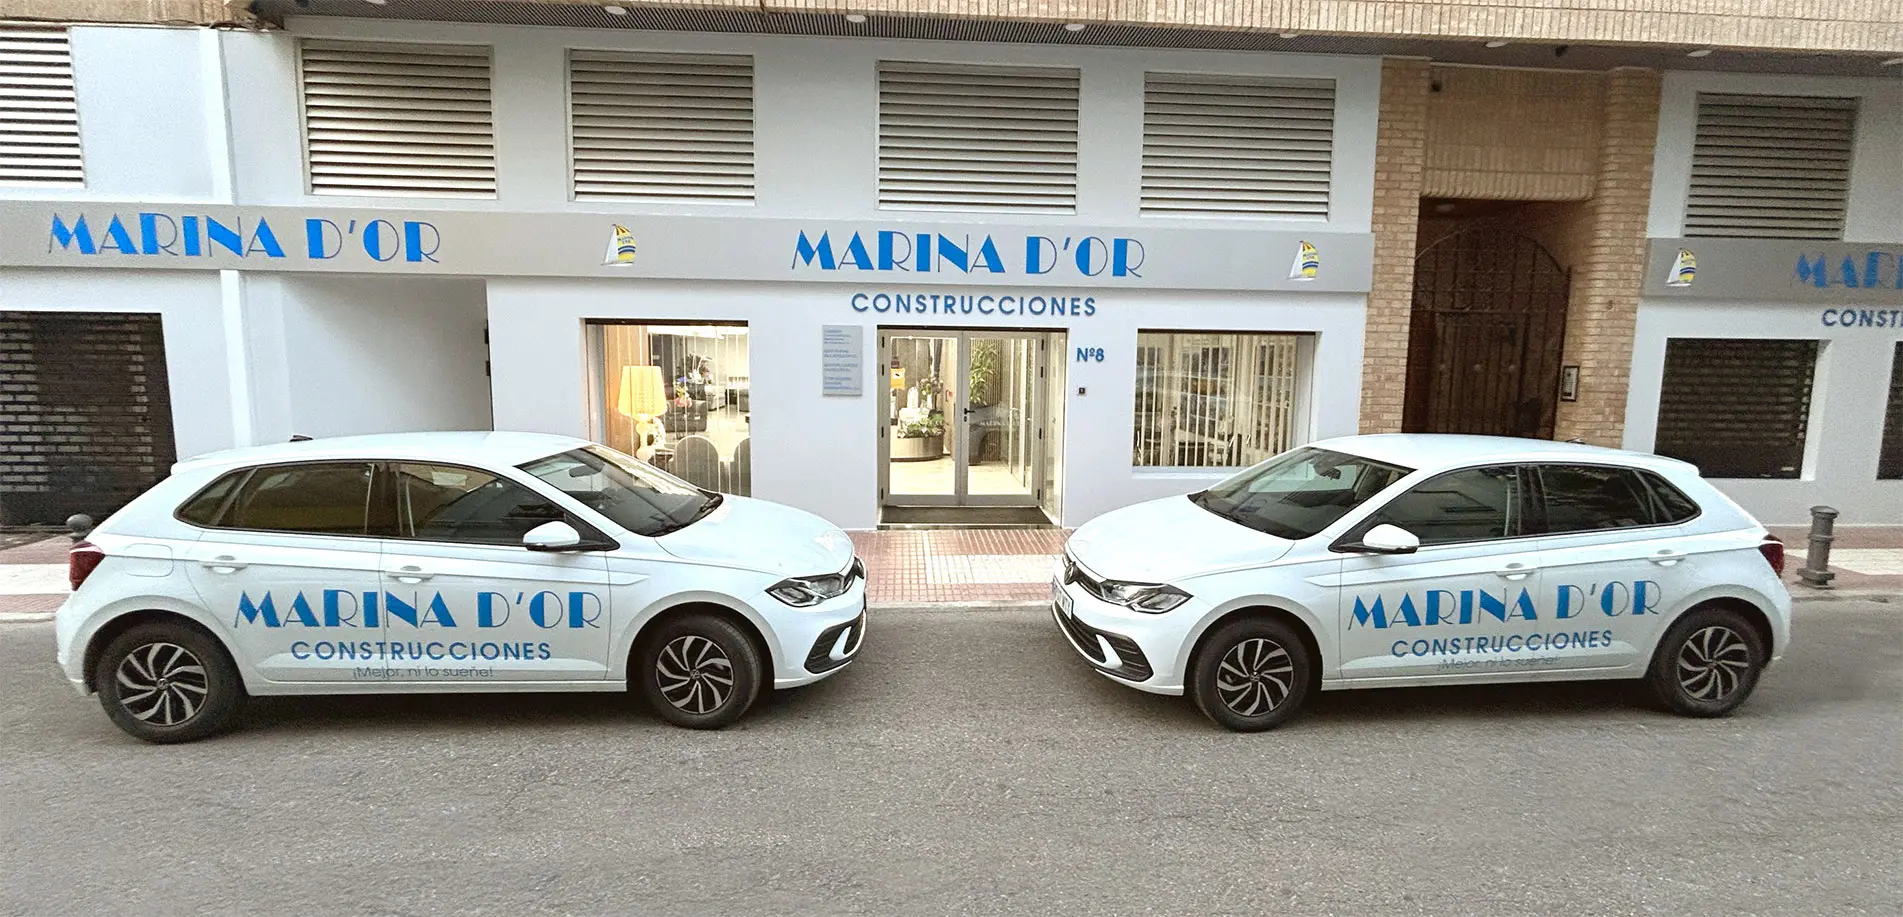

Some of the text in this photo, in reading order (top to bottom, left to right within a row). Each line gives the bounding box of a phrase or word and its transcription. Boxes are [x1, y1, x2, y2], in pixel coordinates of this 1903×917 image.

[48, 211, 441, 264] MARINA D'OR
[792, 229, 1146, 279] MARINA D'OR
[850, 292, 1097, 316] CONSTRUCCIONES
[1821, 308, 1903, 328] CONST
[234, 589, 602, 629] MARINA D'OR
[1348, 579, 1662, 630] MARINA D'OR
[290, 641, 552, 661] CONSTRUCCIONES
[1391, 630, 1613, 658] CONSTRUCCIONES
[408, 665, 420, 677] ni
[425, 666, 438, 677] lo
